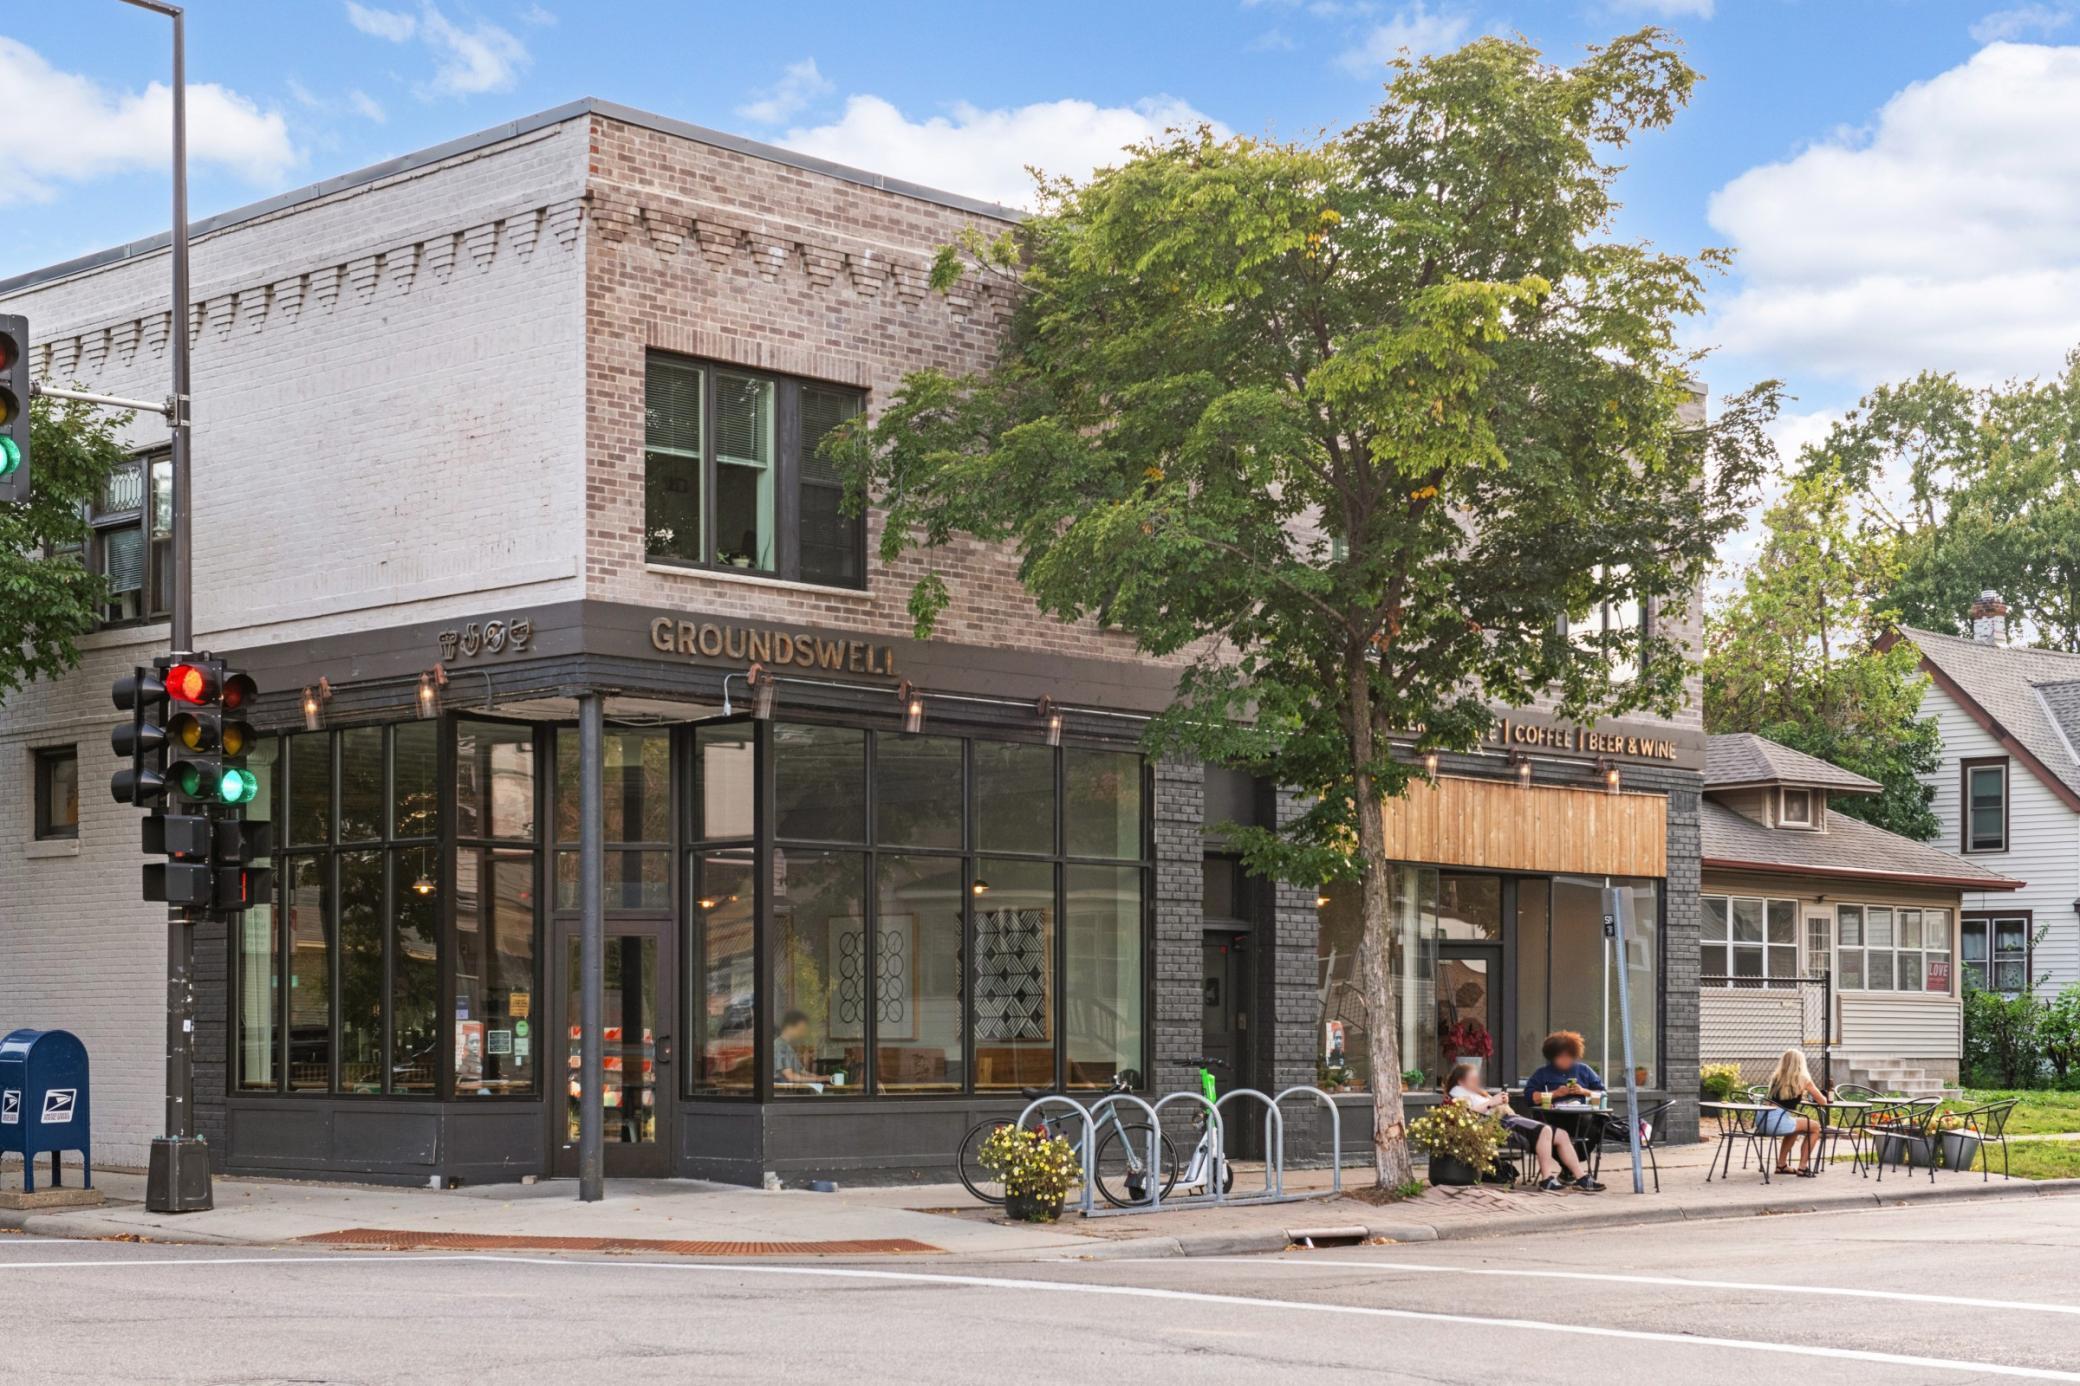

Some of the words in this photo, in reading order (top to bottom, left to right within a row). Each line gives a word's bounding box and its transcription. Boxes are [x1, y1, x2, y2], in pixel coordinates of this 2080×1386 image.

[650, 616, 898, 676] GROUNDSWELL
[1514, 724, 1573, 748] COFFEE
[1588, 732, 1624, 753] BEER
[1628, 735, 1638, 755] &
[1639, 737, 1677, 760] WINE
[1929, 963, 1949, 977] LOVE
